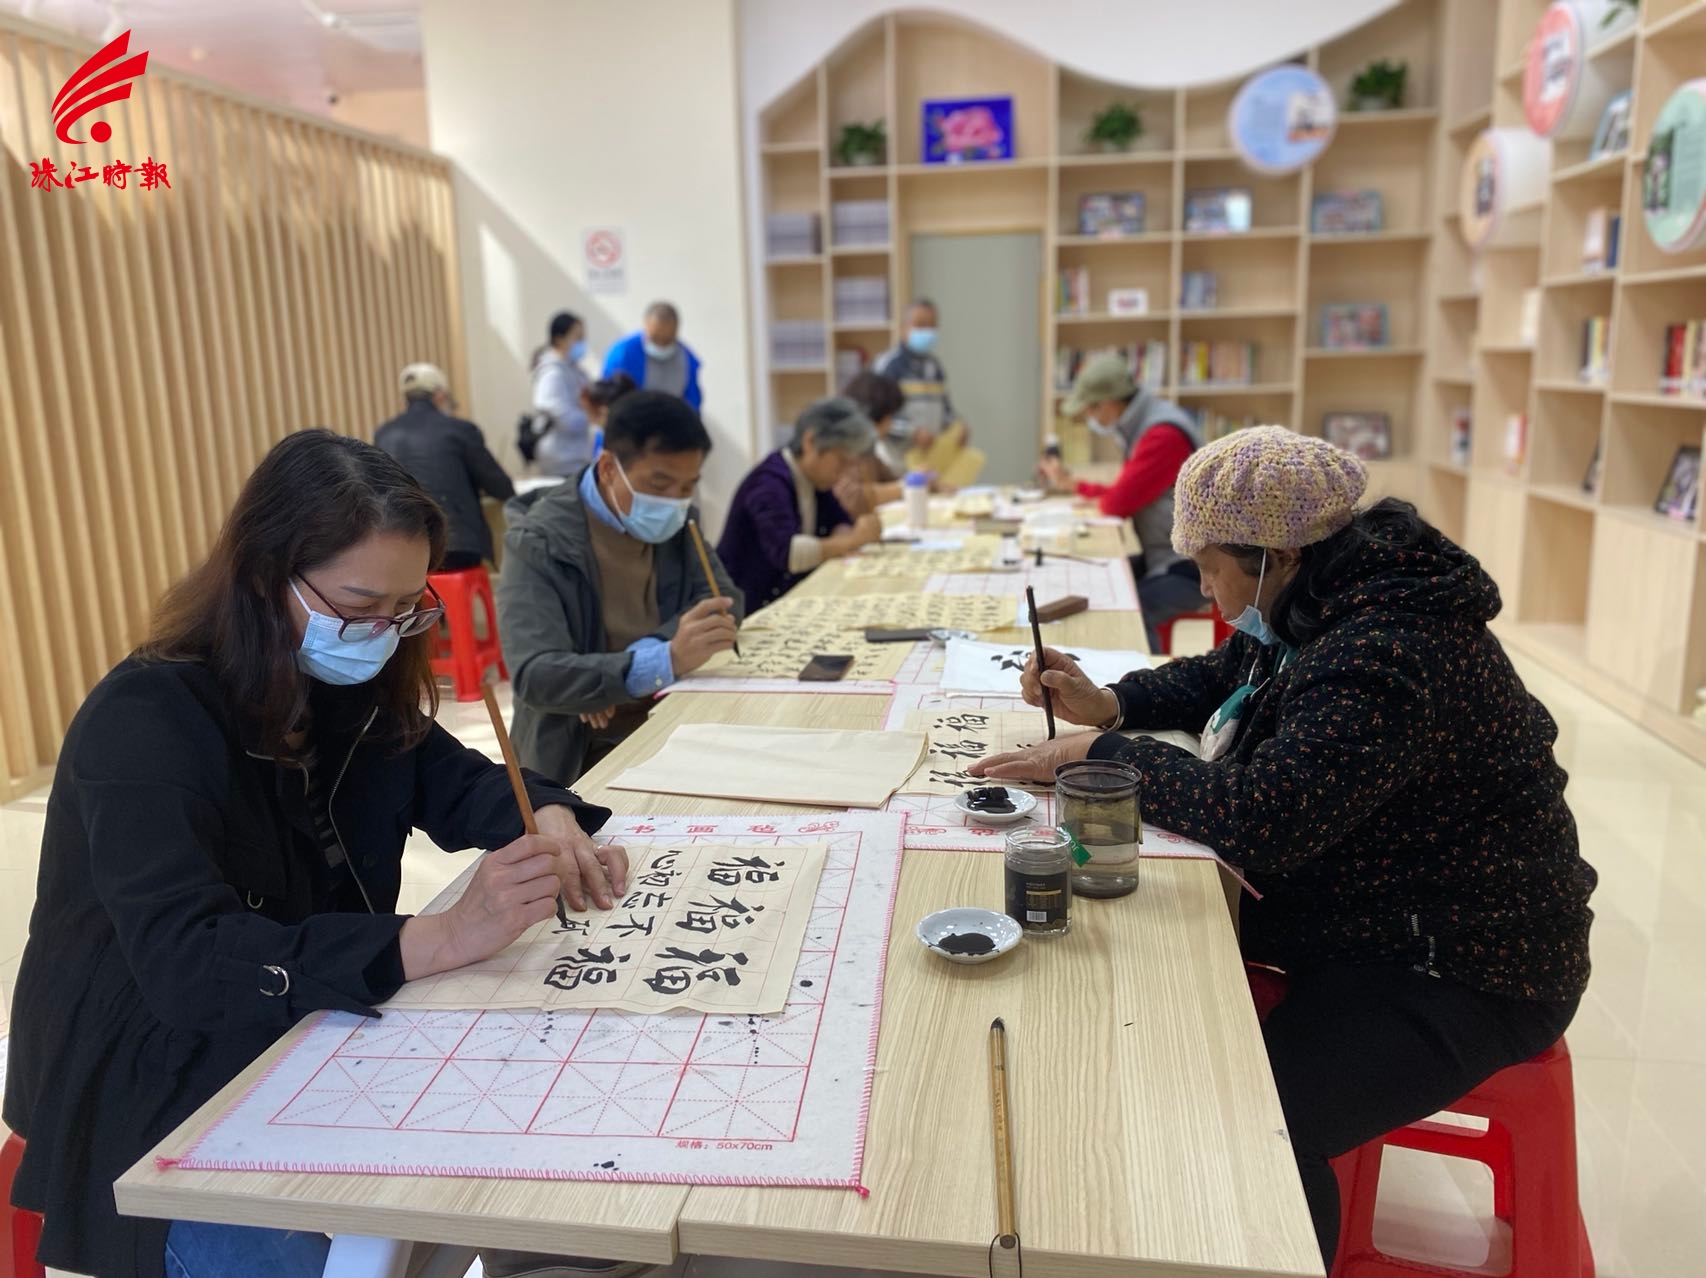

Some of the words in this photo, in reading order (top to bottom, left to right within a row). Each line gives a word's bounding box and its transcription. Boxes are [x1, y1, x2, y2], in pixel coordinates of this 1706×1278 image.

[707, 856, 785, 886] 福
[675, 894, 765, 934] 福
[543, 945, 631, 990] 福
[642, 946, 749, 995] 福
